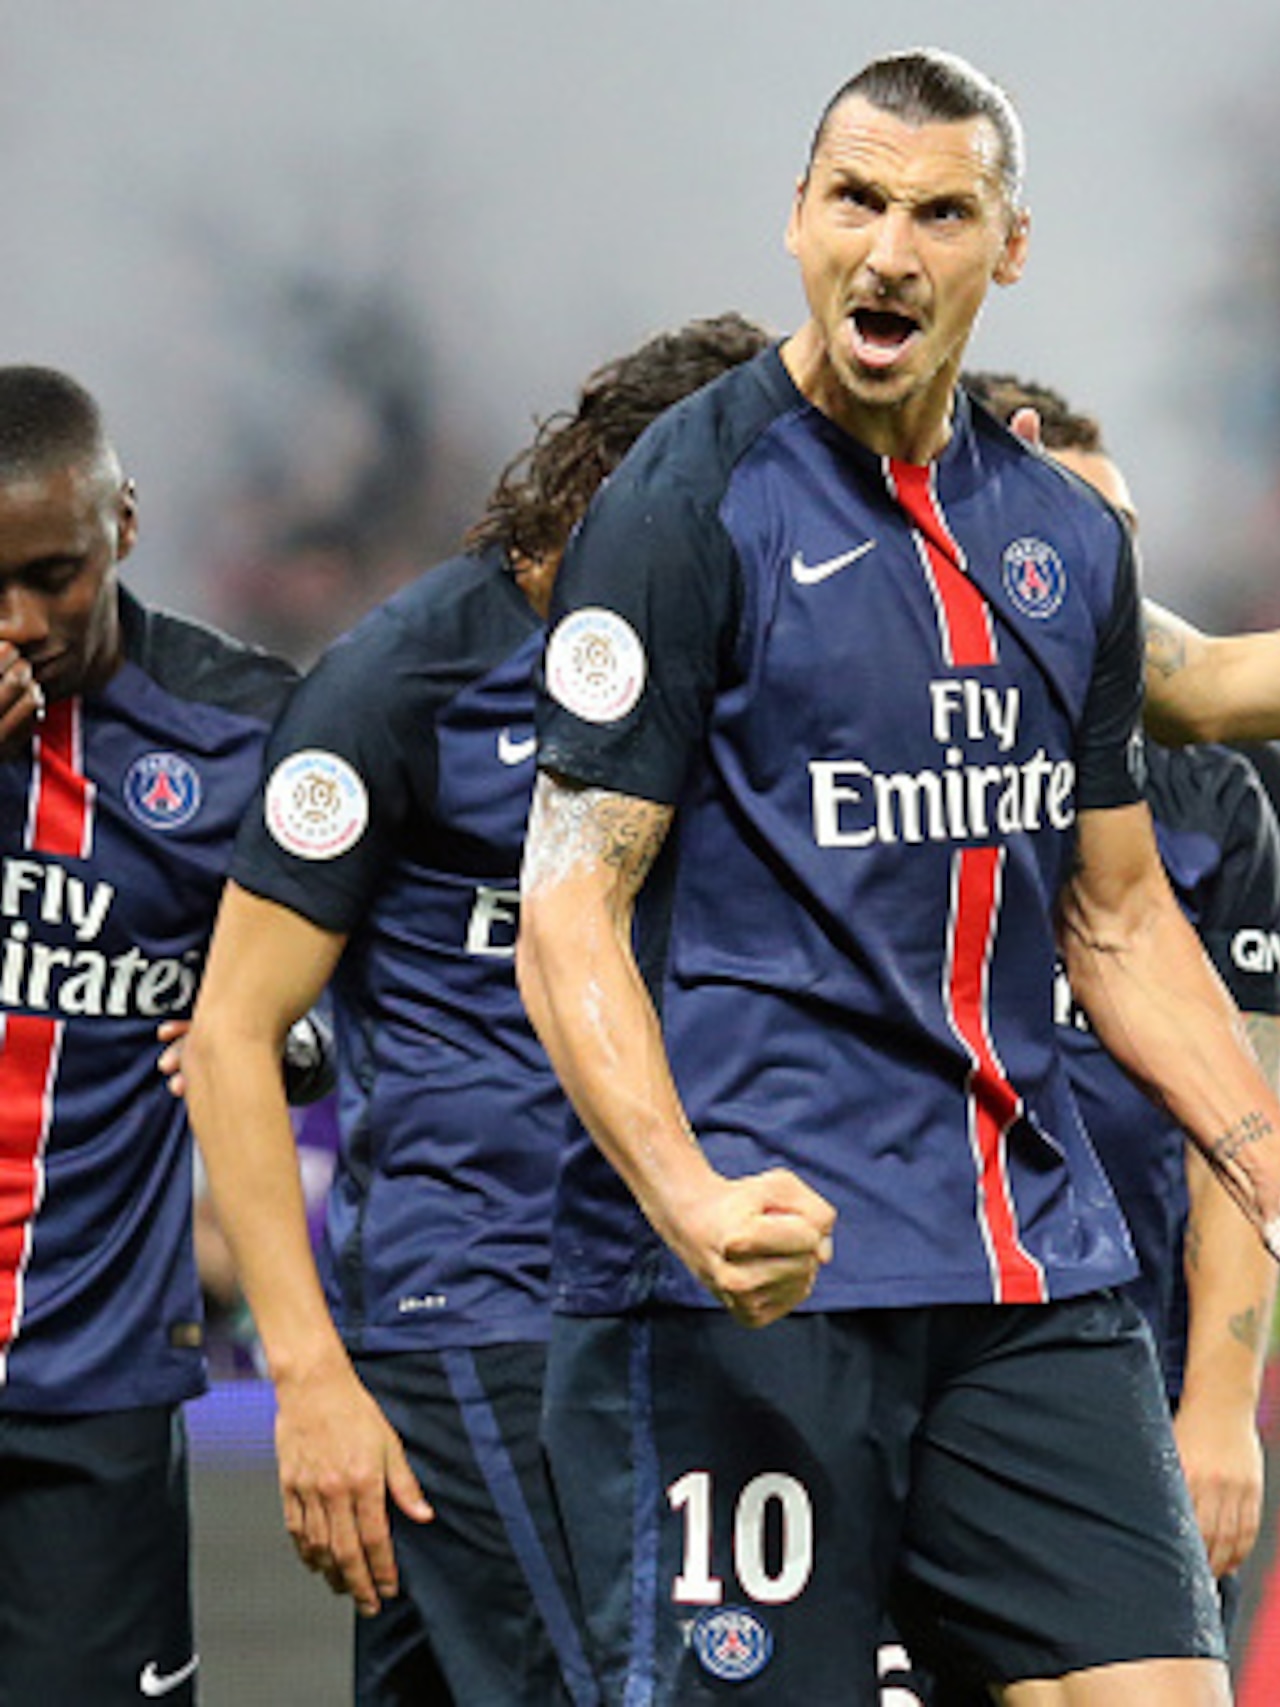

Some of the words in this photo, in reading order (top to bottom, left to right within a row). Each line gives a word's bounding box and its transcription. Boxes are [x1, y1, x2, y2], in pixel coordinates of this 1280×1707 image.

[929, 679, 1020, 750] Fly
[3, 858, 115, 942] Fly
[667, 1472, 813, 1605] 10
